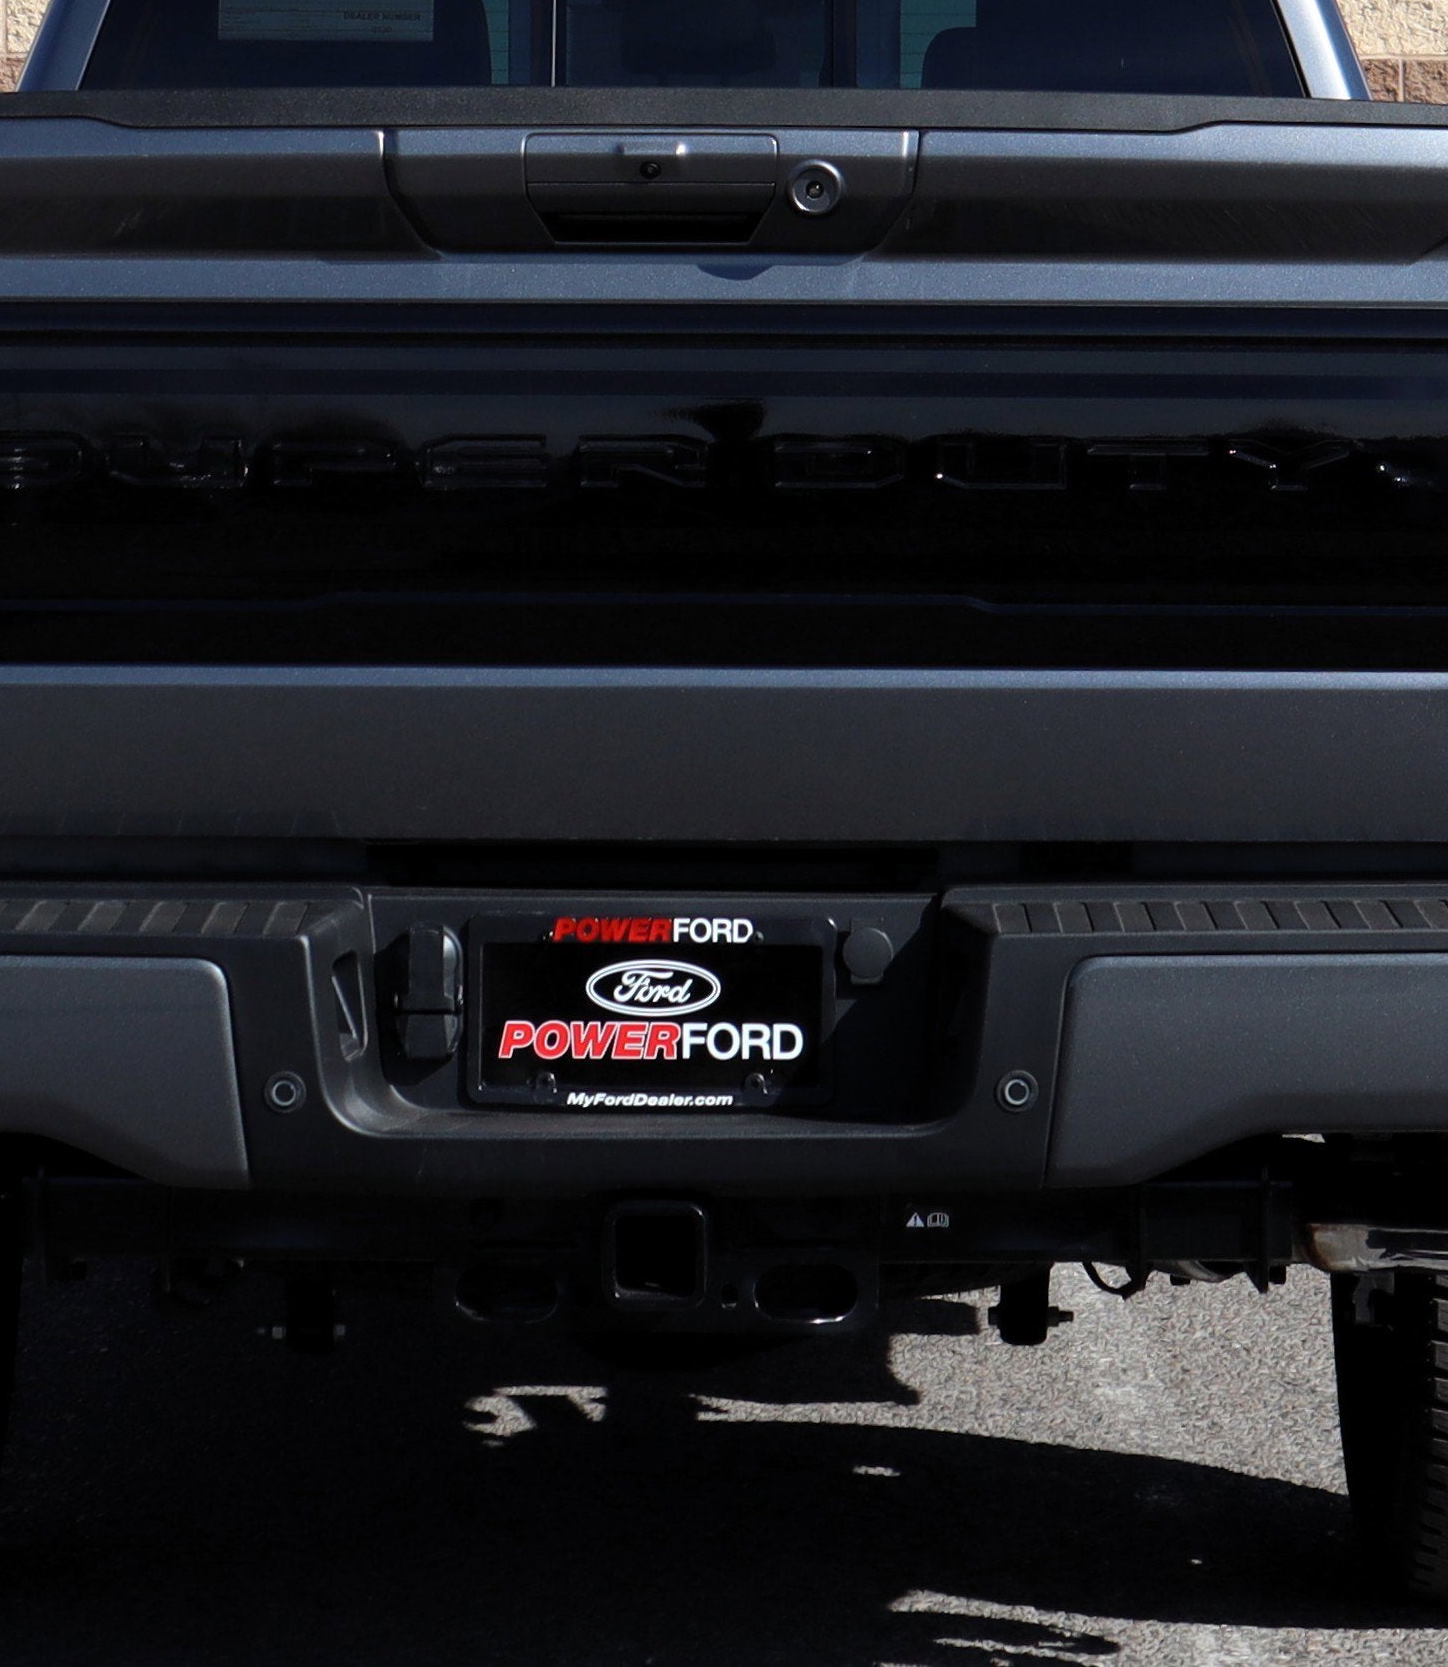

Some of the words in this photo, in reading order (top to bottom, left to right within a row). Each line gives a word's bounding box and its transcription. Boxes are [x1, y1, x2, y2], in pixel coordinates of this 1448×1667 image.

[552, 916, 754, 944] POWERFORD
[613, 969, 691, 1004] Ford
[497, 1019, 804, 1061] POWERFORD
[566, 1091, 734, 1108] MyFordDealer.com
